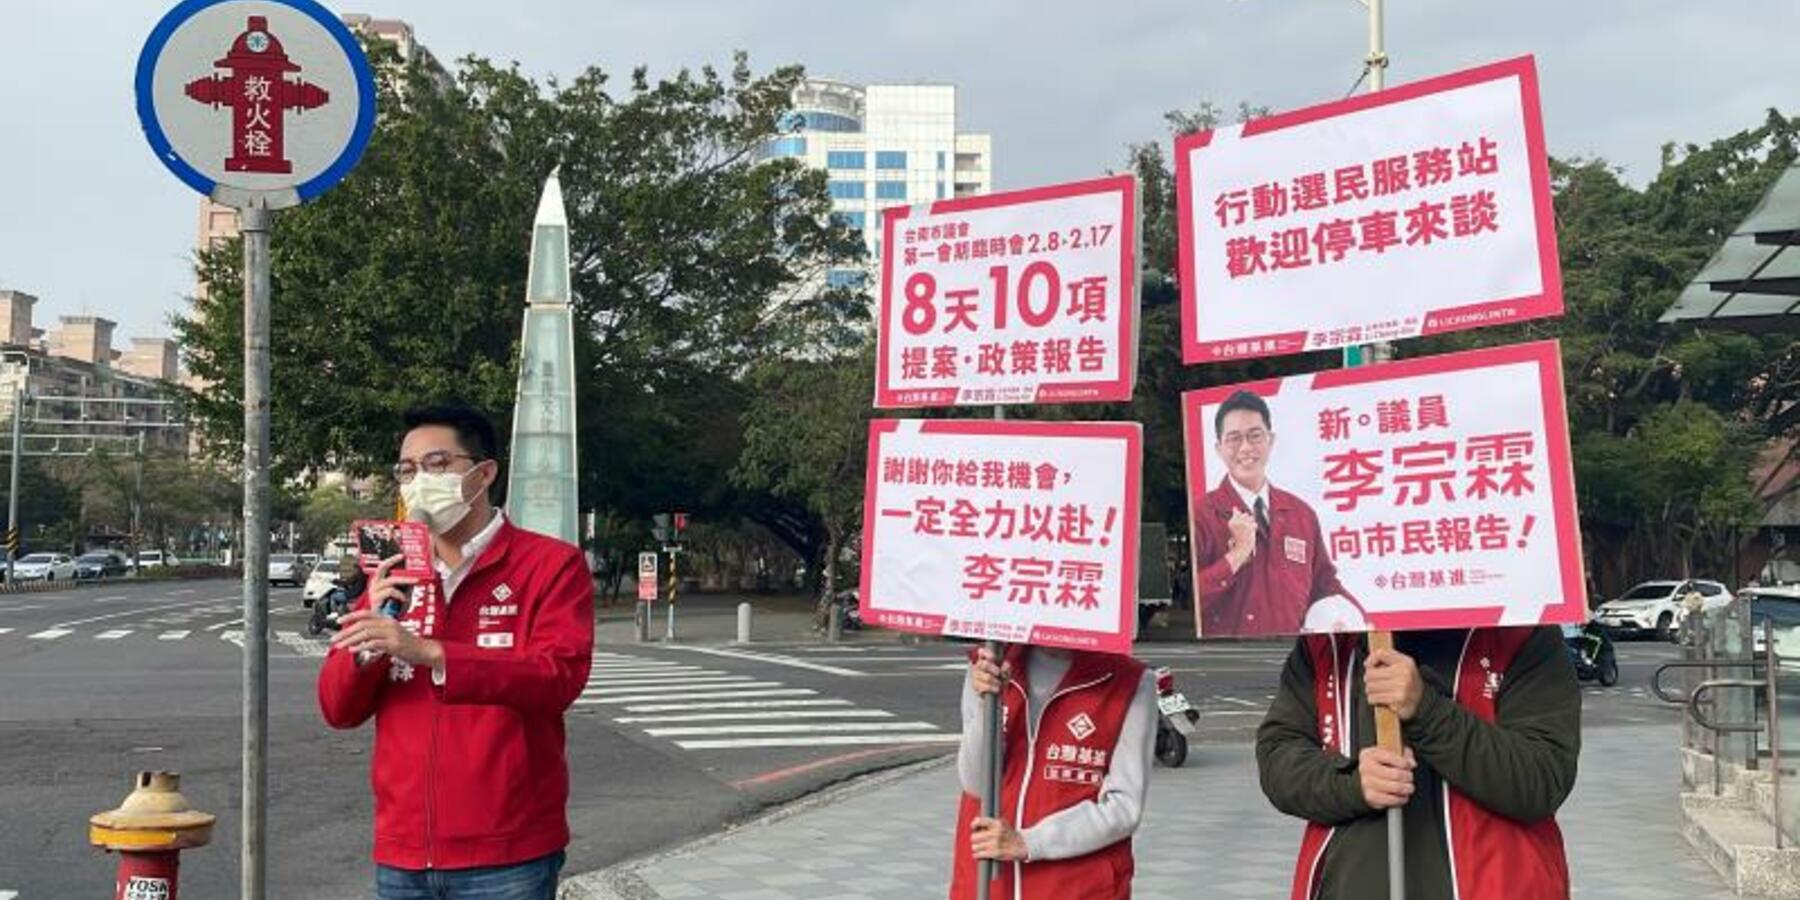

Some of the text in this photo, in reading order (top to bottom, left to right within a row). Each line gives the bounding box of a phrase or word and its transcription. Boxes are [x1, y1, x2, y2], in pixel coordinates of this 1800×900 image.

[244, 76, 272, 156] 救火栓
[1214, 137, 1499, 228] 行動選民服務站
[904, 221, 970, 244] 台南市議會
[1226, 189, 1499, 278] 歡迎停車來談
[902, 261, 1108, 335] 8天10項
[883, 457, 1072, 490] 謝謝你給我機會，
[1323, 431, 1535, 513] 李宗霖
[881, 496, 1117, 548] 一定全力以赴！
[1329, 513, 1536, 561] 向市民報告！
[962, 554, 1103, 610] 李宗霖
